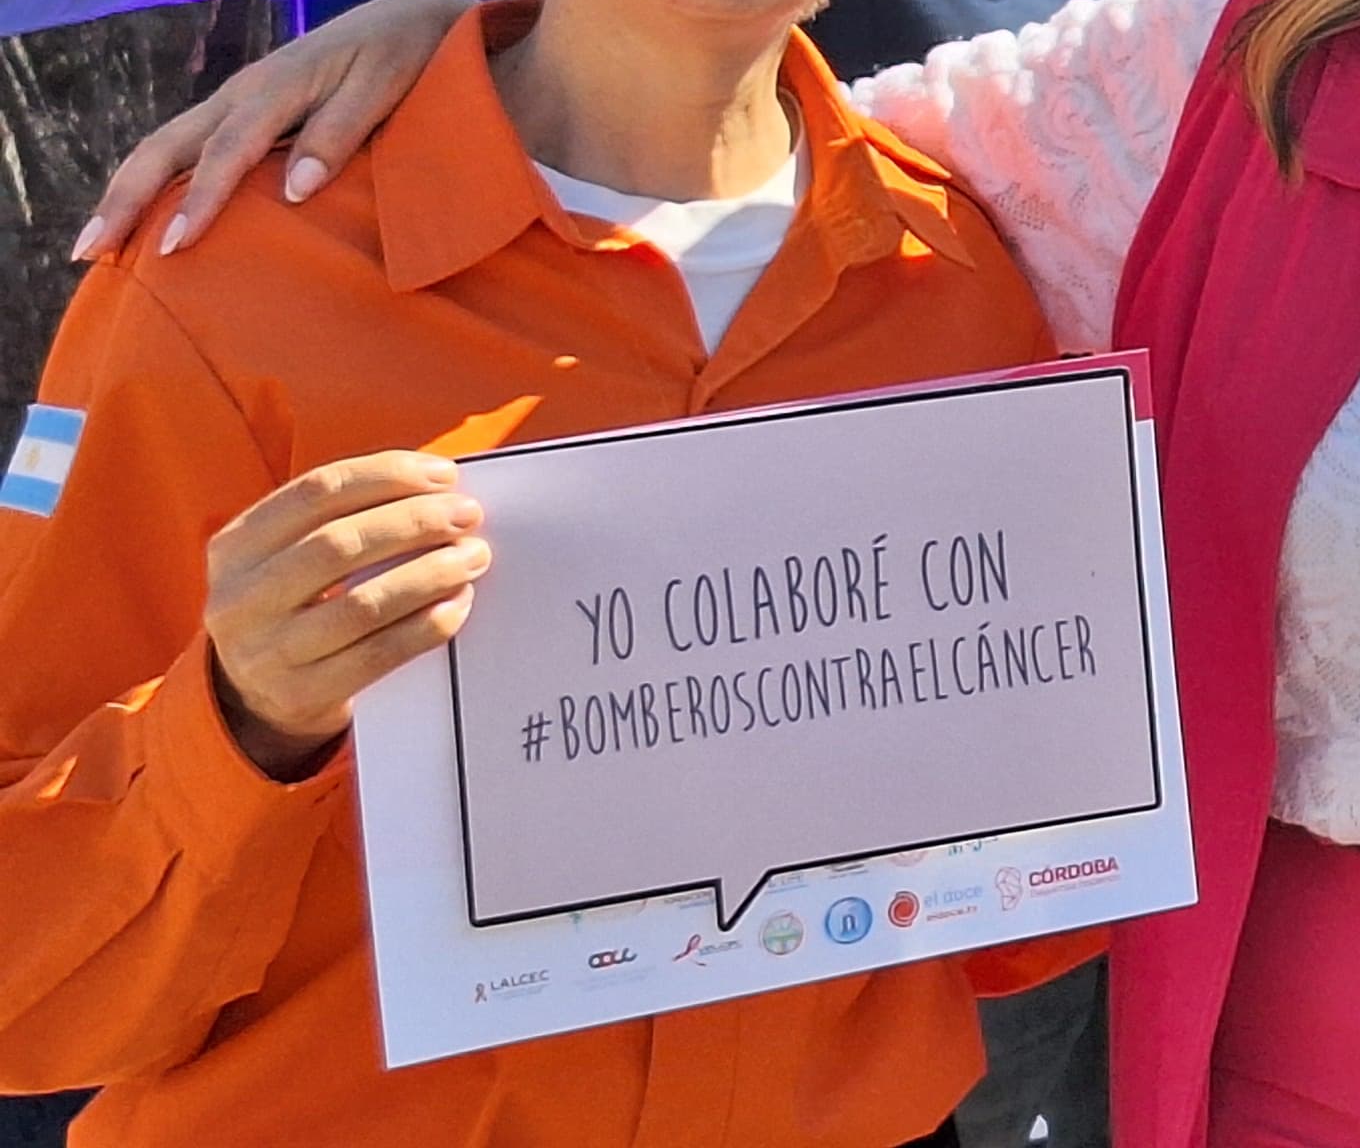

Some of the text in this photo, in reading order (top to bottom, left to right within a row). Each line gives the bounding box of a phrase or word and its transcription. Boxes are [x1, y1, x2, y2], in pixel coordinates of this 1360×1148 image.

[575, 529, 1010, 665] YO COLABORÉ CON
[521, 613, 1098, 763] #BOMBEROSCONTRAELCÁNCER
[1028, 856, 1120, 888] CÓRDOBA
[490, 968, 550, 991] LALCEC
